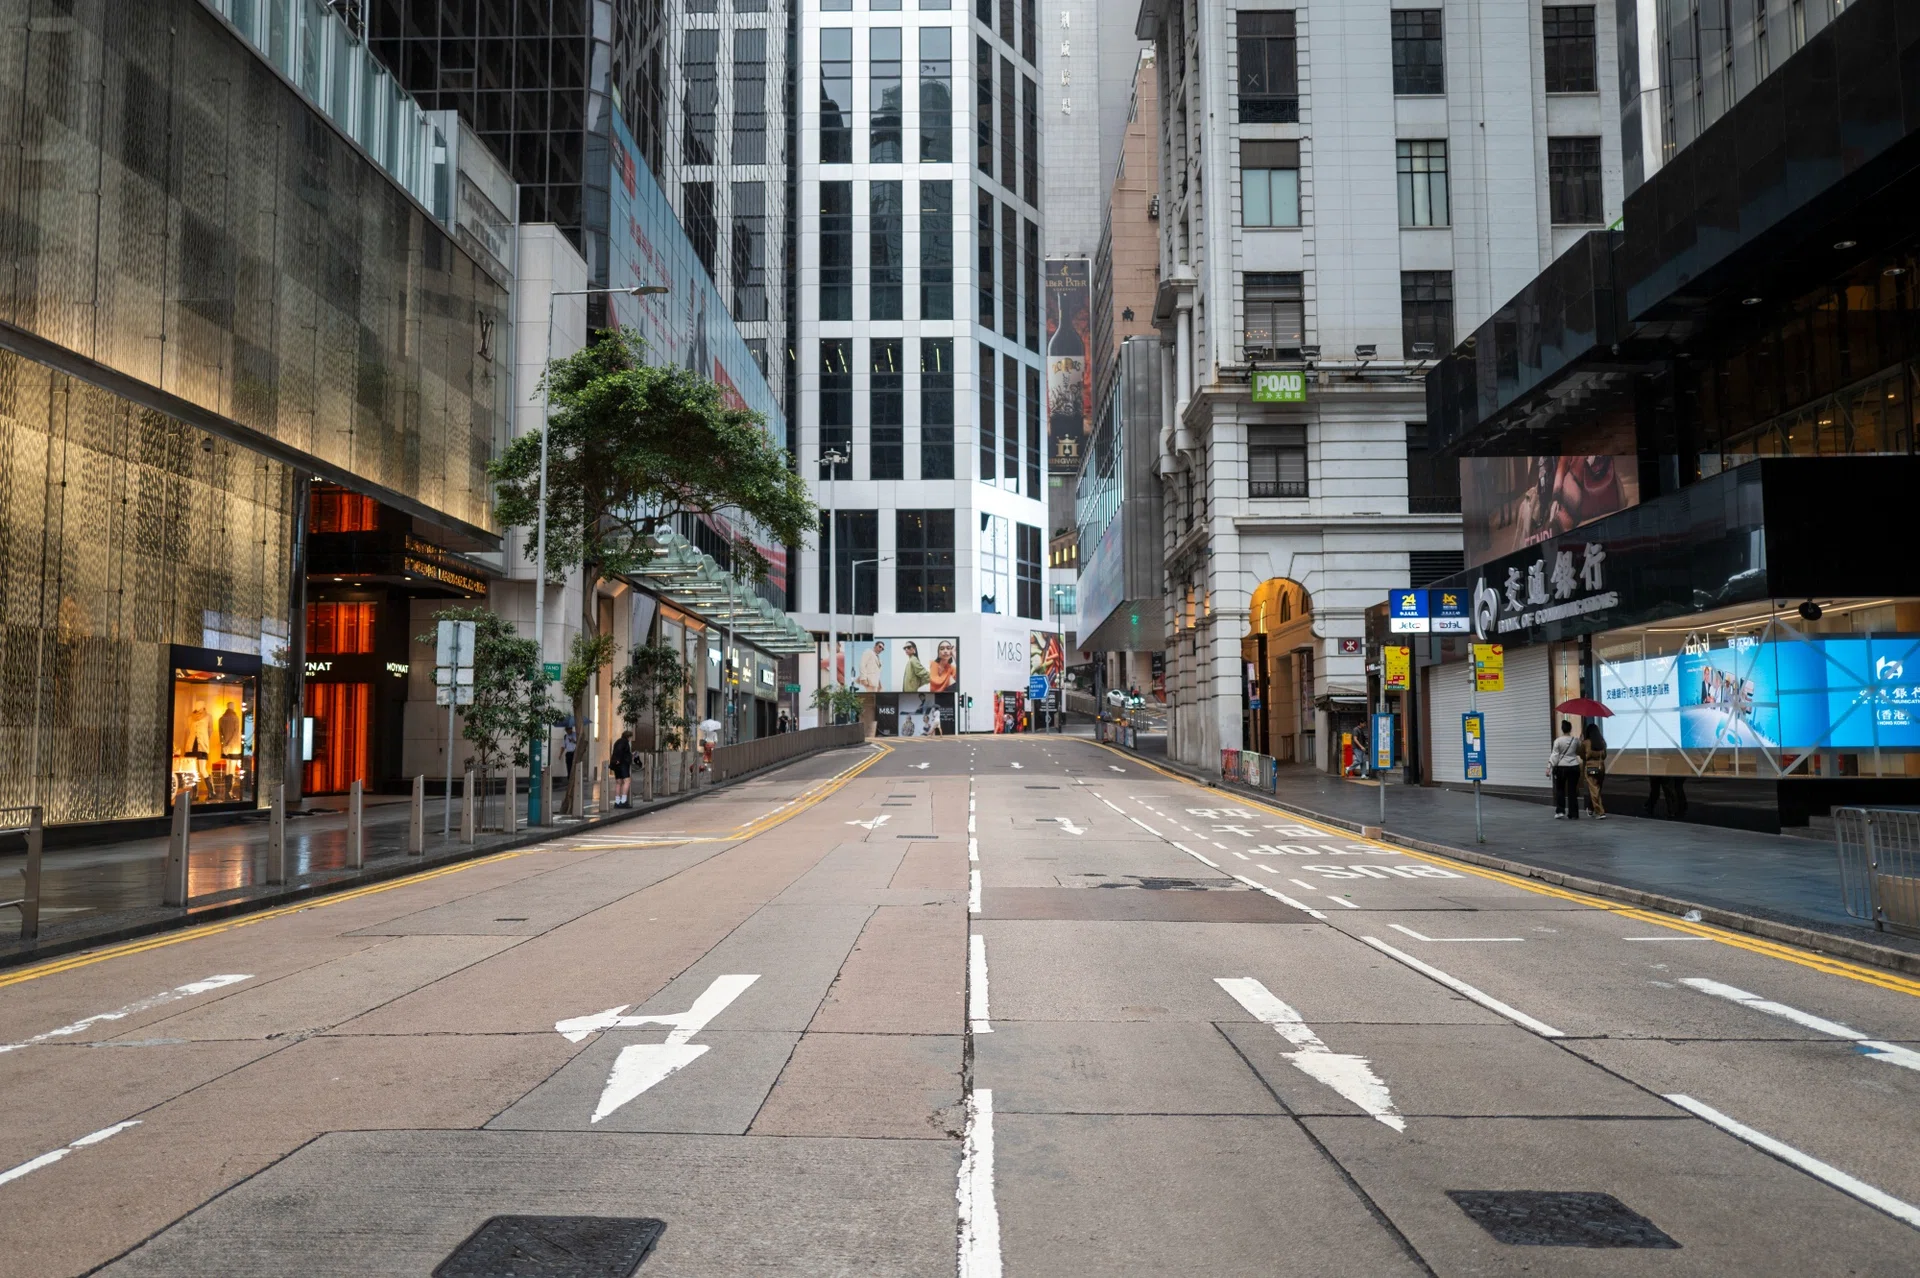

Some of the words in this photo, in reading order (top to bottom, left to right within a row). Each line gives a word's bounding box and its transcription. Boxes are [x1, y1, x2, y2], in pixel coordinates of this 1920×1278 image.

[1257, 375, 1302, 391] POAD
[1504, 542, 1607, 612] 交通銀行
[1402, 593, 1416, 606] 24
[1521, 612, 1535, 629] OF
[997, 641, 1023, 662] M&S
[879, 706, 896, 715] M&S
[1248, 843, 1404, 856] STOP
[1301, 864, 1468, 879] BUS
